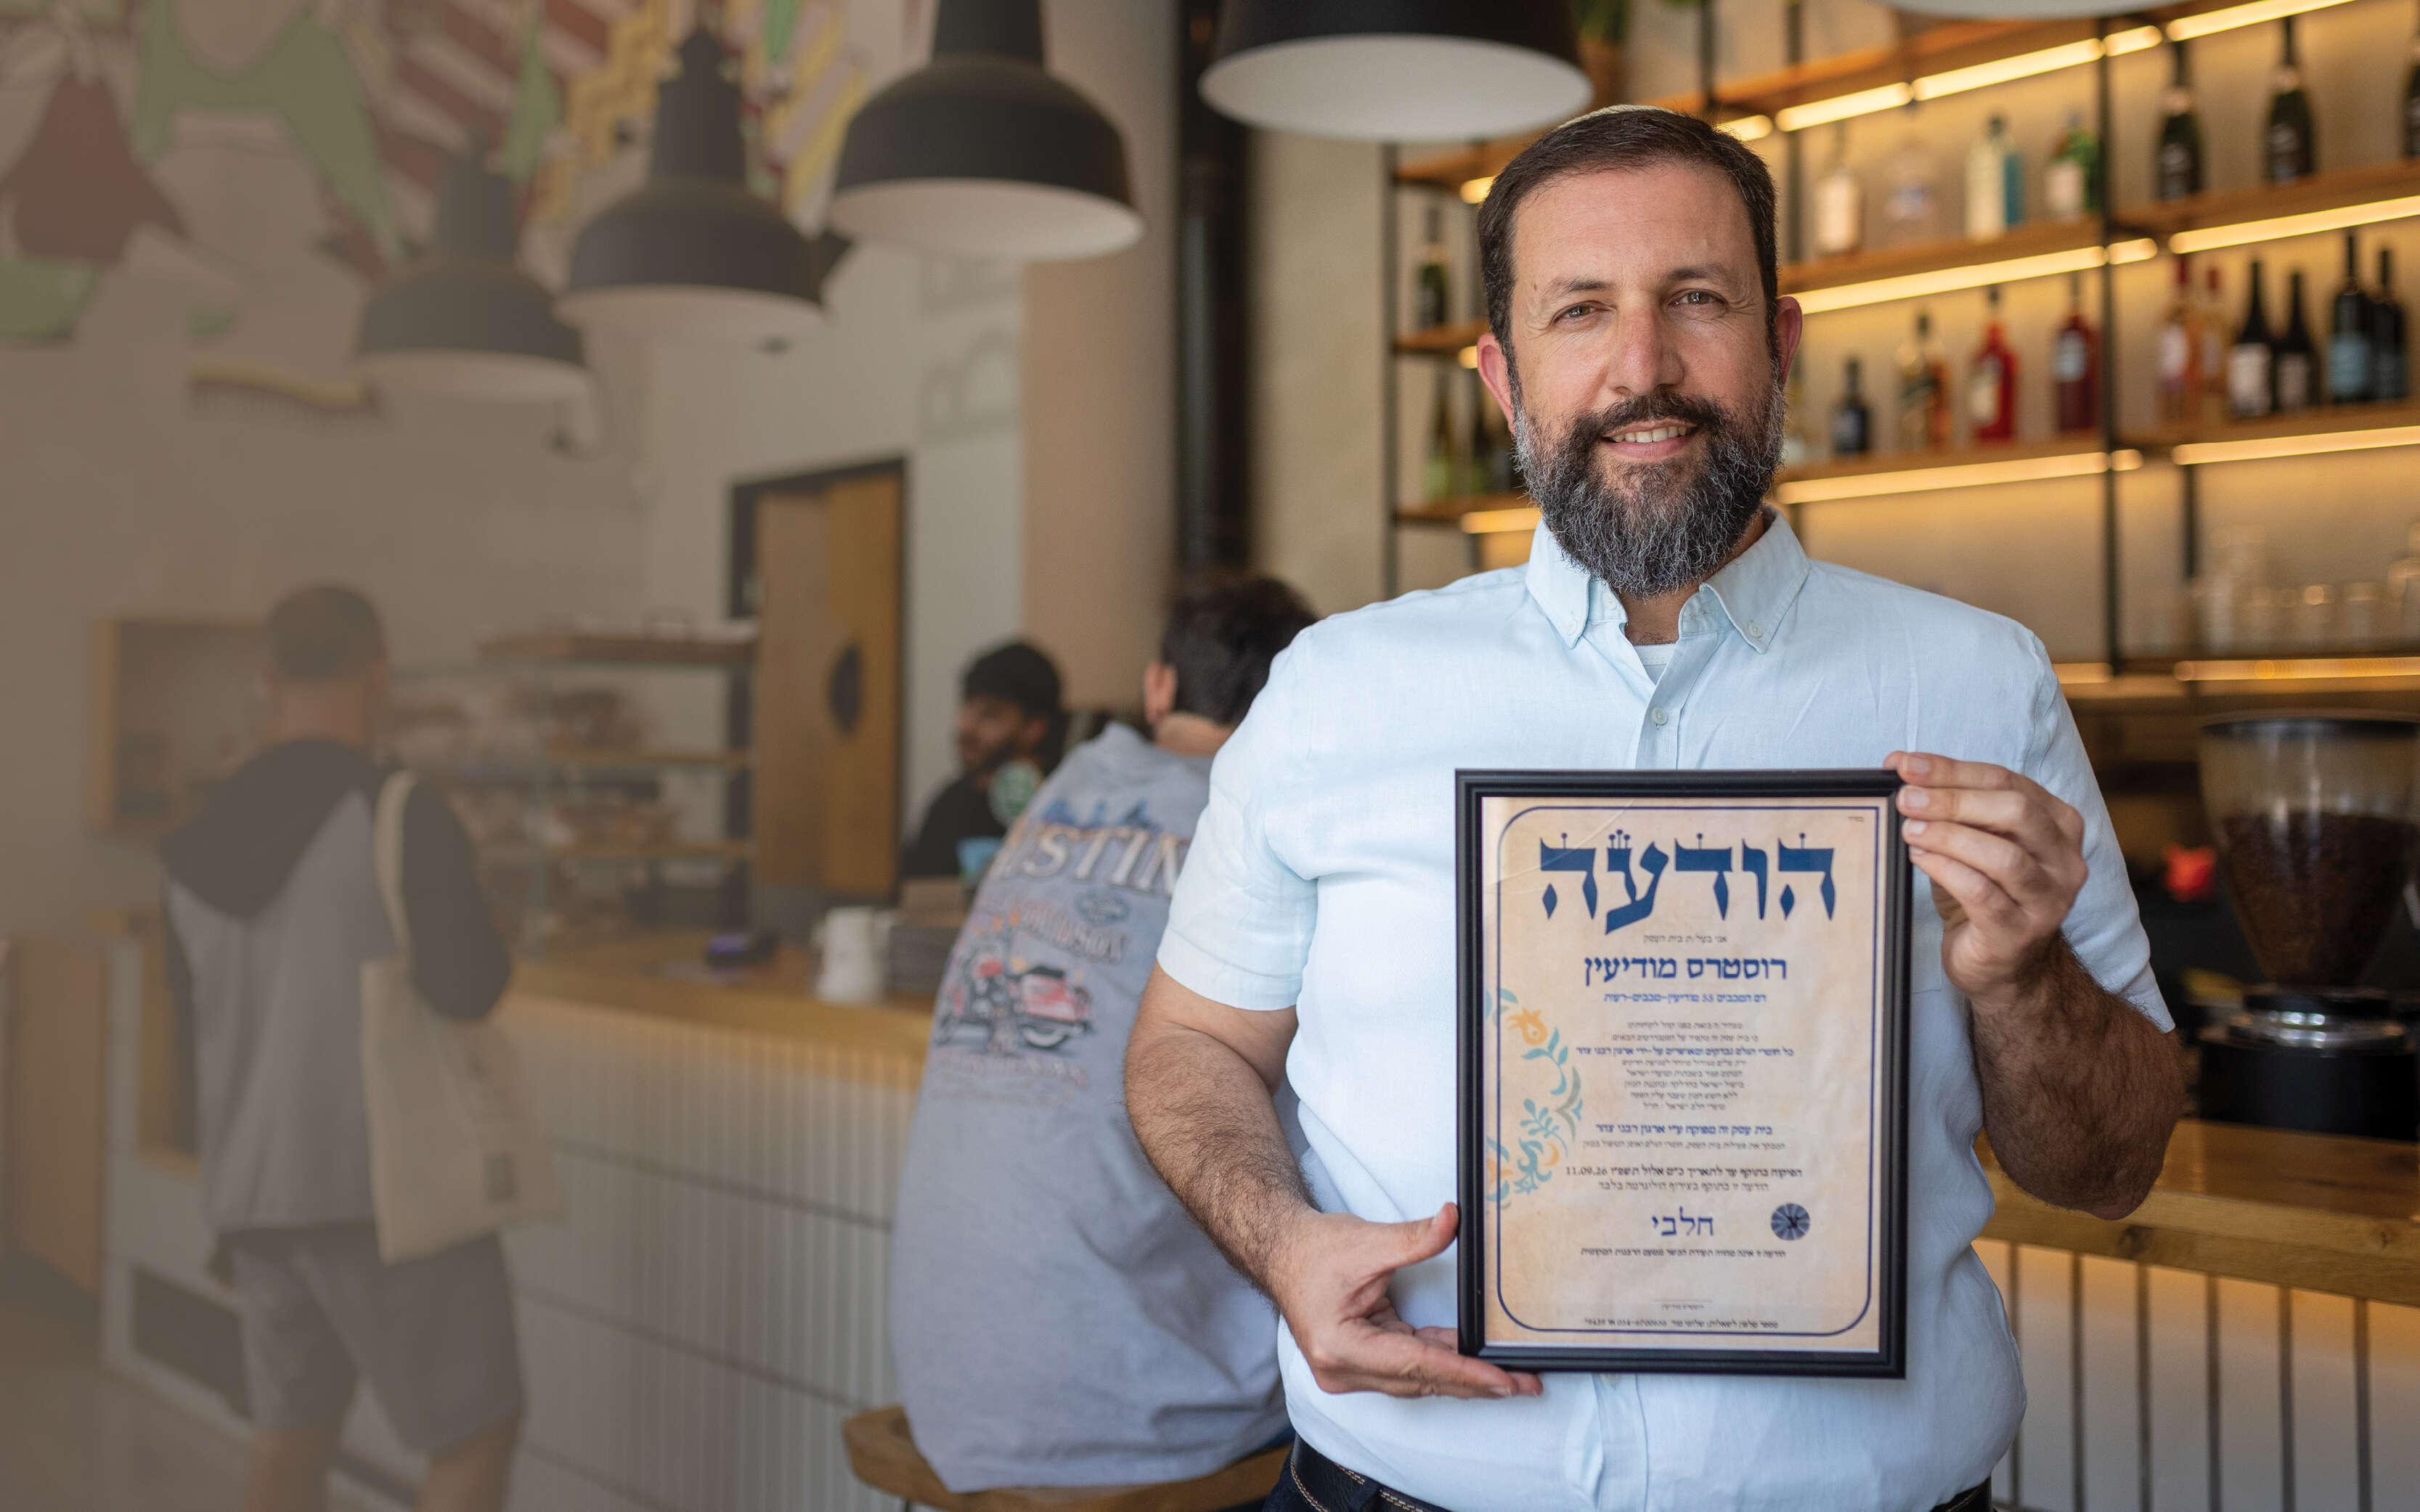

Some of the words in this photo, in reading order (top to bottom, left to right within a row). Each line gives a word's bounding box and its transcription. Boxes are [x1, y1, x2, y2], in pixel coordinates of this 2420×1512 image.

[1540, 829, 1836, 935] הודעה
[1584, 957, 1677, 986] מודיעין
[1687, 957, 1786, 979] רוסטרס
[1652, 1206, 1714, 1237] חלבי
